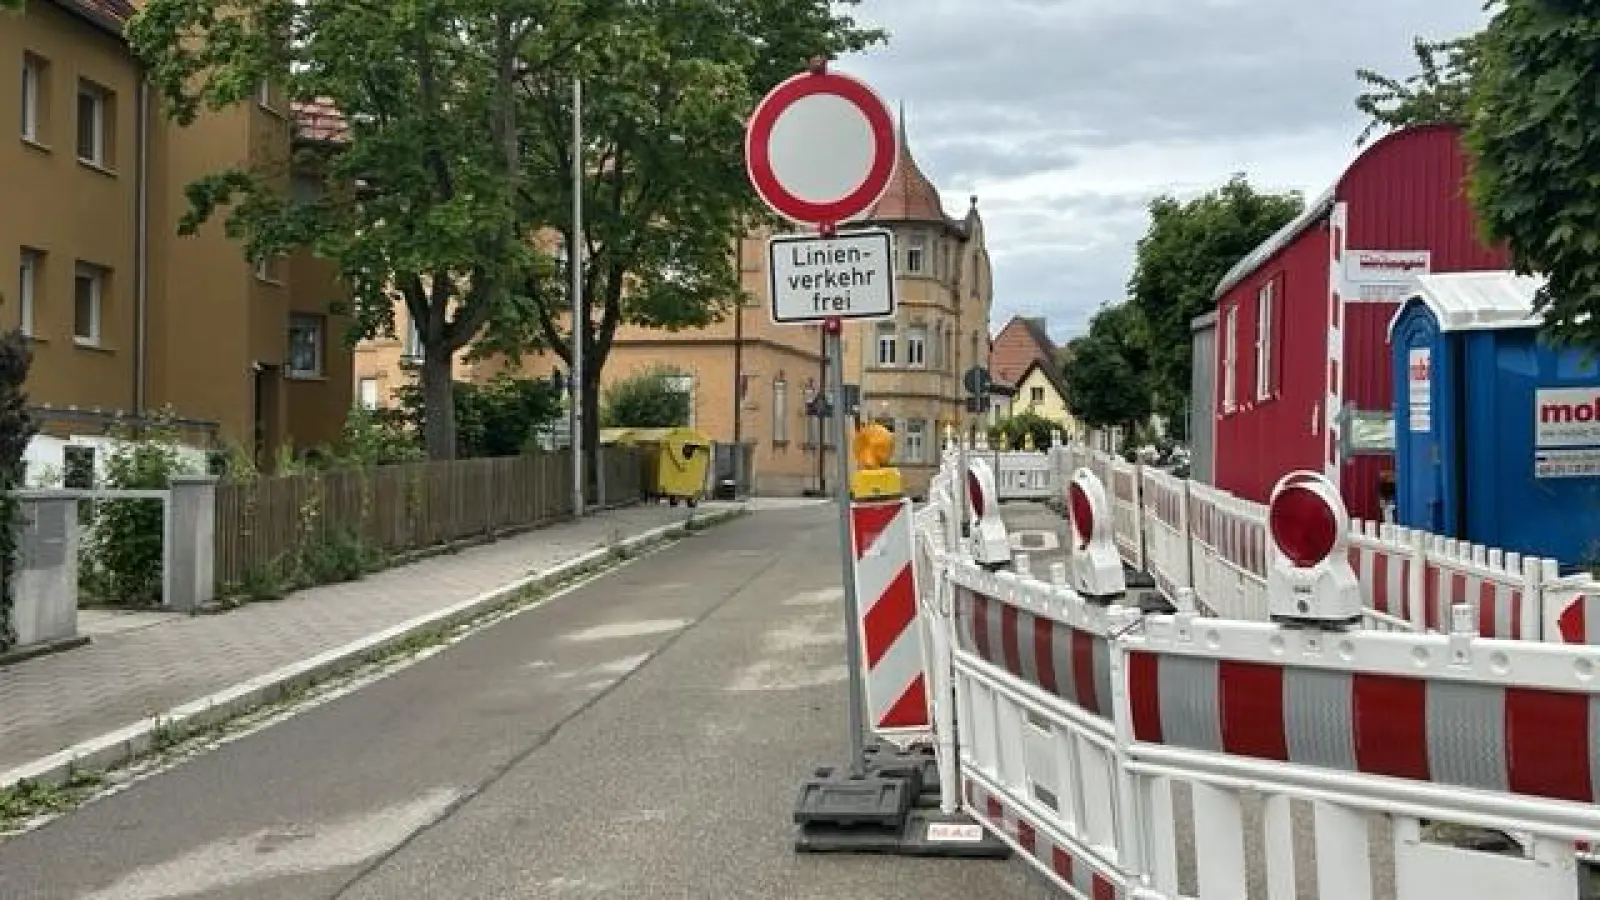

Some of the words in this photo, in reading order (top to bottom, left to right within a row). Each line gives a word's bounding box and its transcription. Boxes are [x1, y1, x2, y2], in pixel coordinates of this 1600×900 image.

[791, 244, 872, 268] Linien-
[787, 267, 876, 291] verkehr
[812, 289, 851, 311] frei
